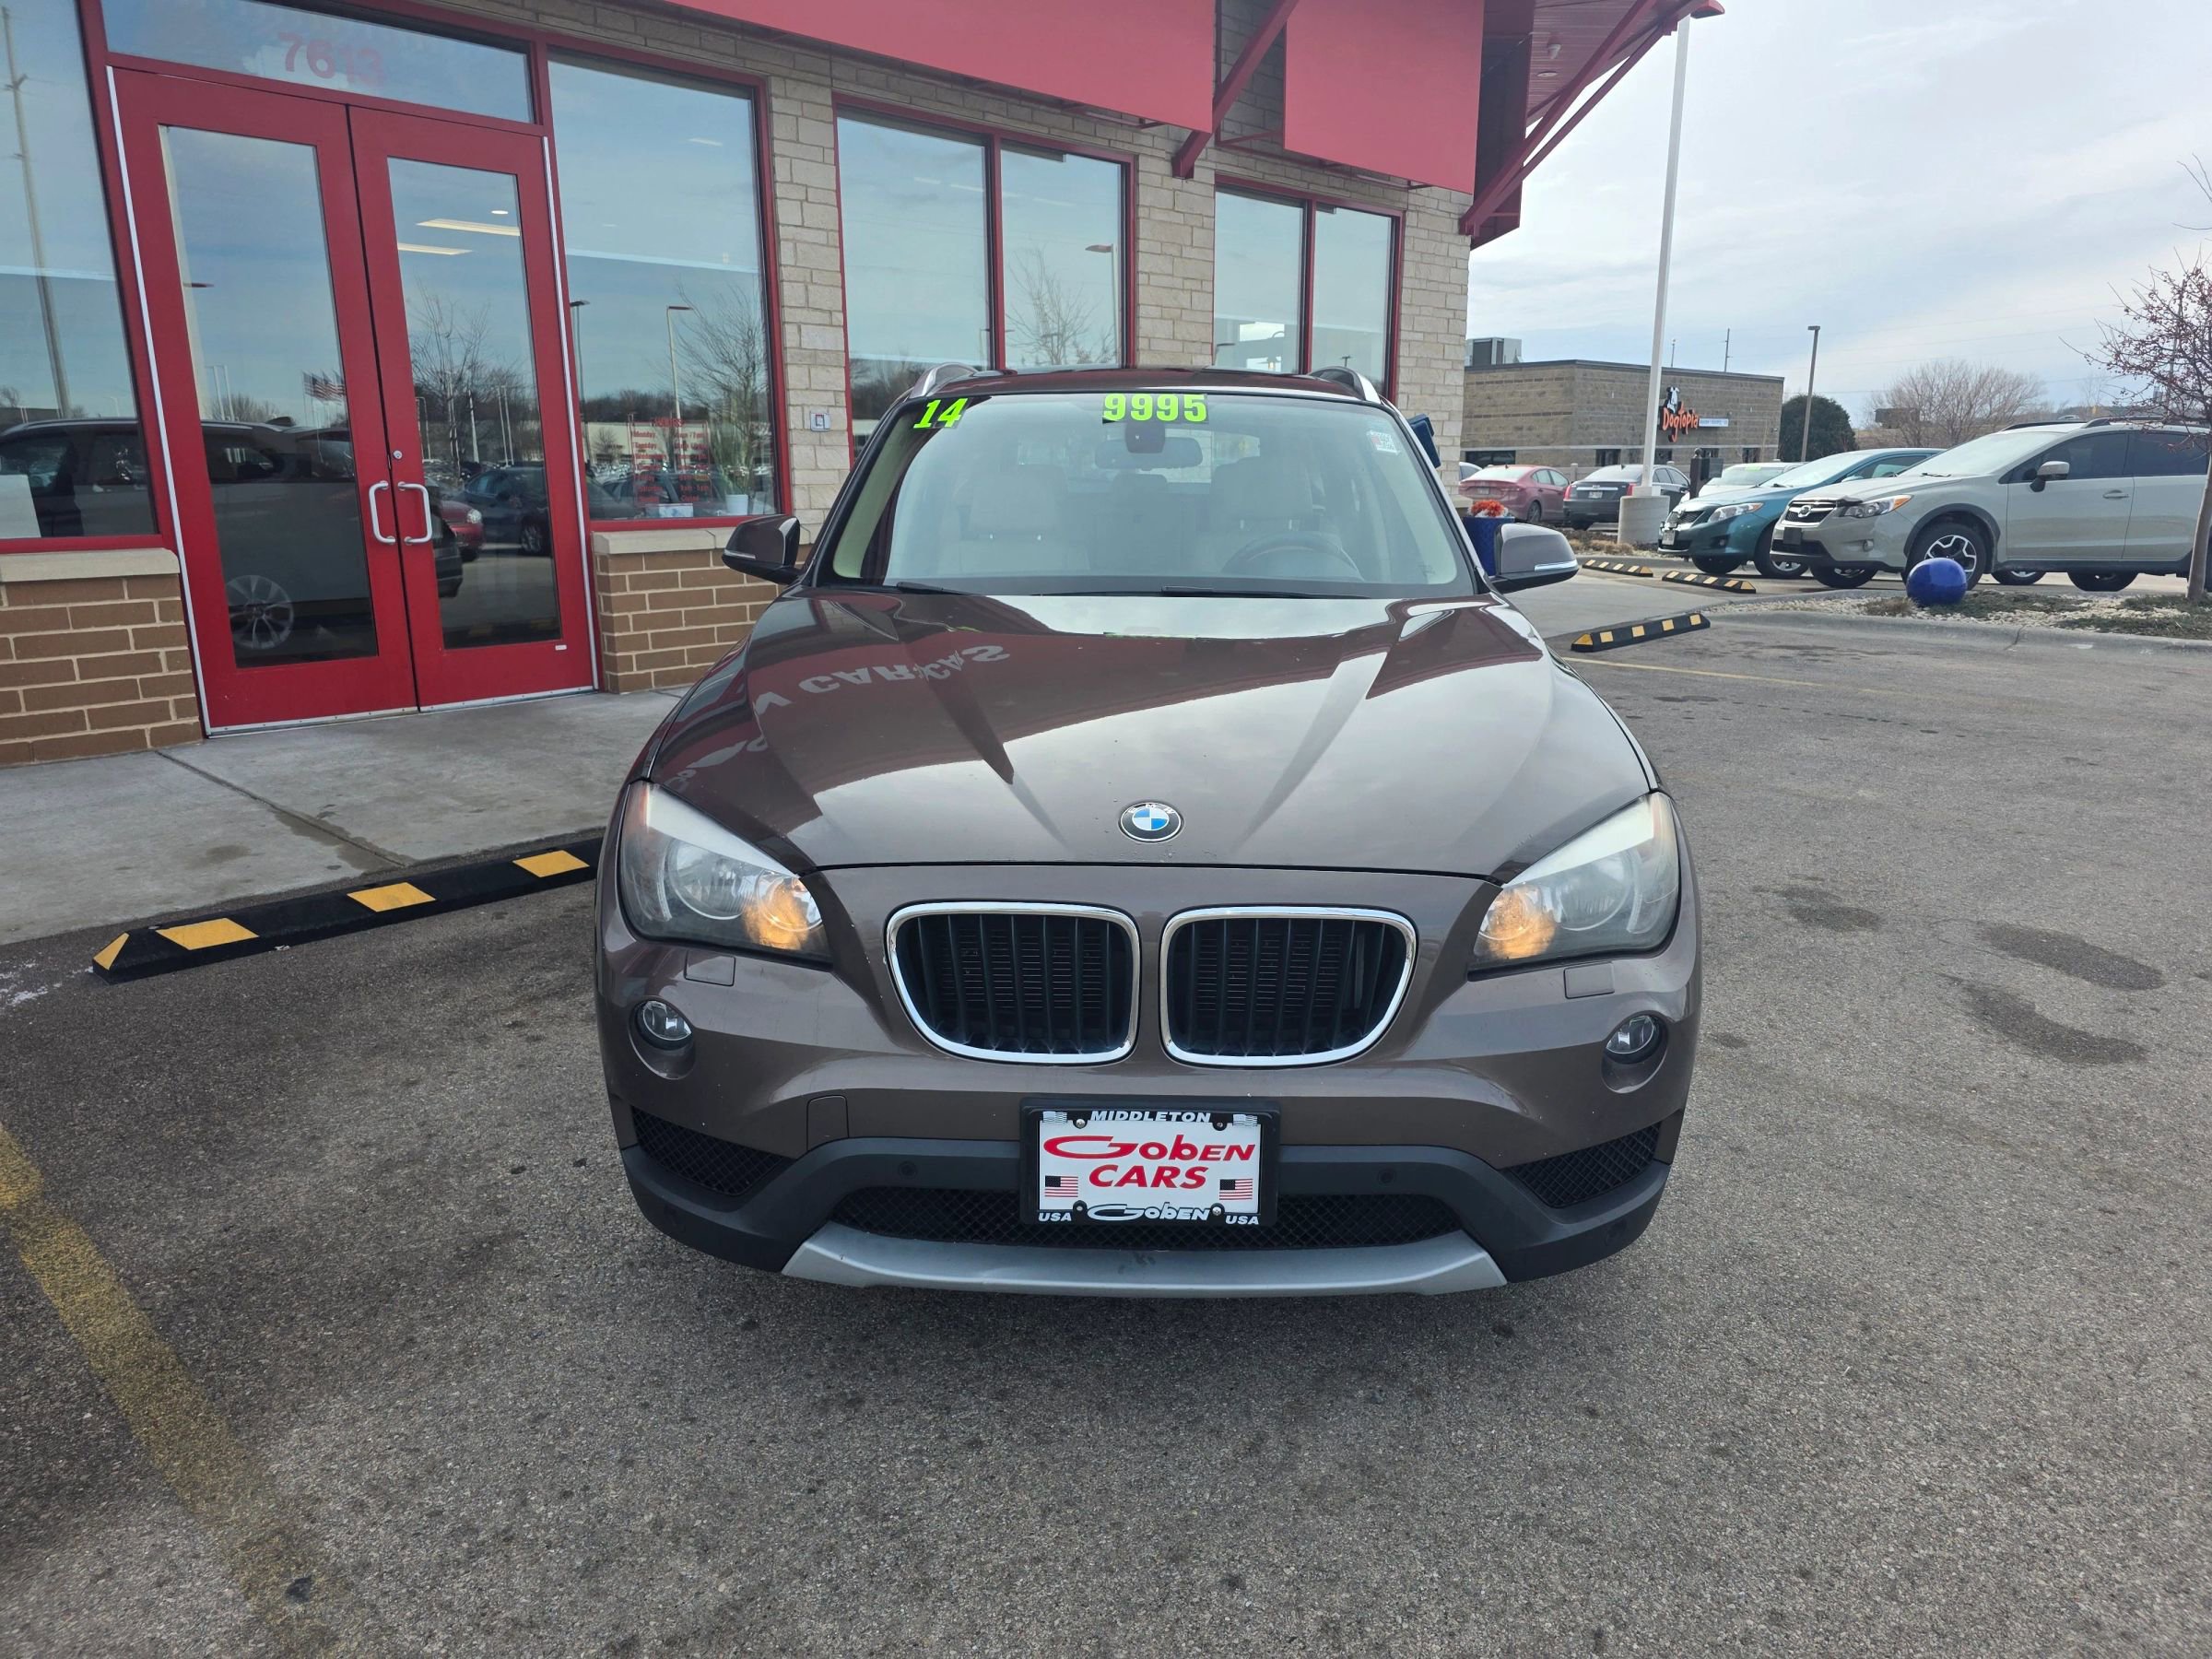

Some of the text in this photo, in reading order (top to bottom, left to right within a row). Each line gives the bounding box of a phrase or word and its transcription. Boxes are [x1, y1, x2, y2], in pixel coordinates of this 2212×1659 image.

[278, 32, 384, 87] 7613
[912, 398, 969, 429] 14
[1102, 394, 1206, 422] 9995
[1090, 1110, 1211, 1124] MIDDLETON
[1088, 1164, 1209, 1189] CARS
[1038, 1212, 1072, 1222] USA
[1225, 1215, 1259, 1225] USA
